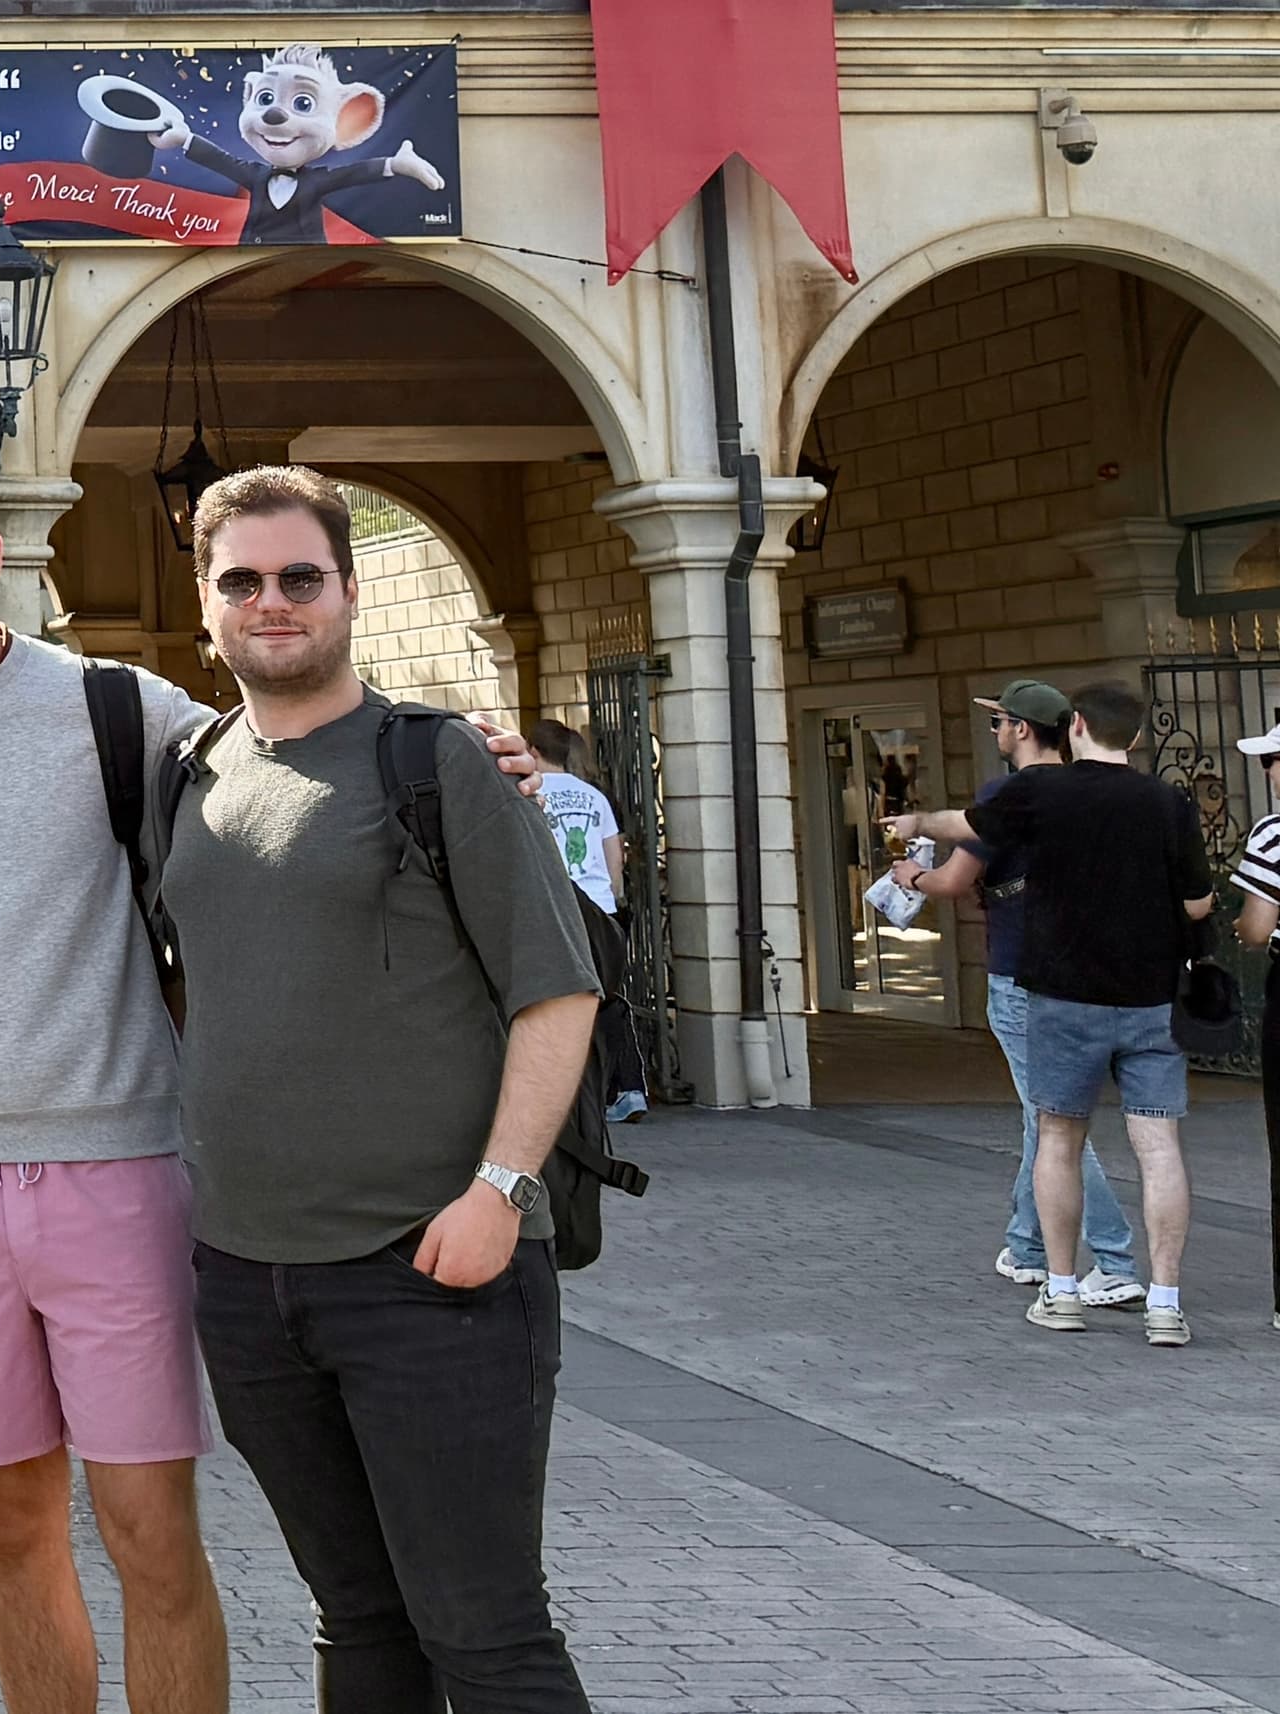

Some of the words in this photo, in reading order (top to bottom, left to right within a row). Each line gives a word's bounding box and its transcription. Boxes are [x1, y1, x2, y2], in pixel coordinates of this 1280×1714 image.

[27, 173, 98, 204] Merci
[110, 184, 176, 226] Thank
[174, 213, 221, 239] you
